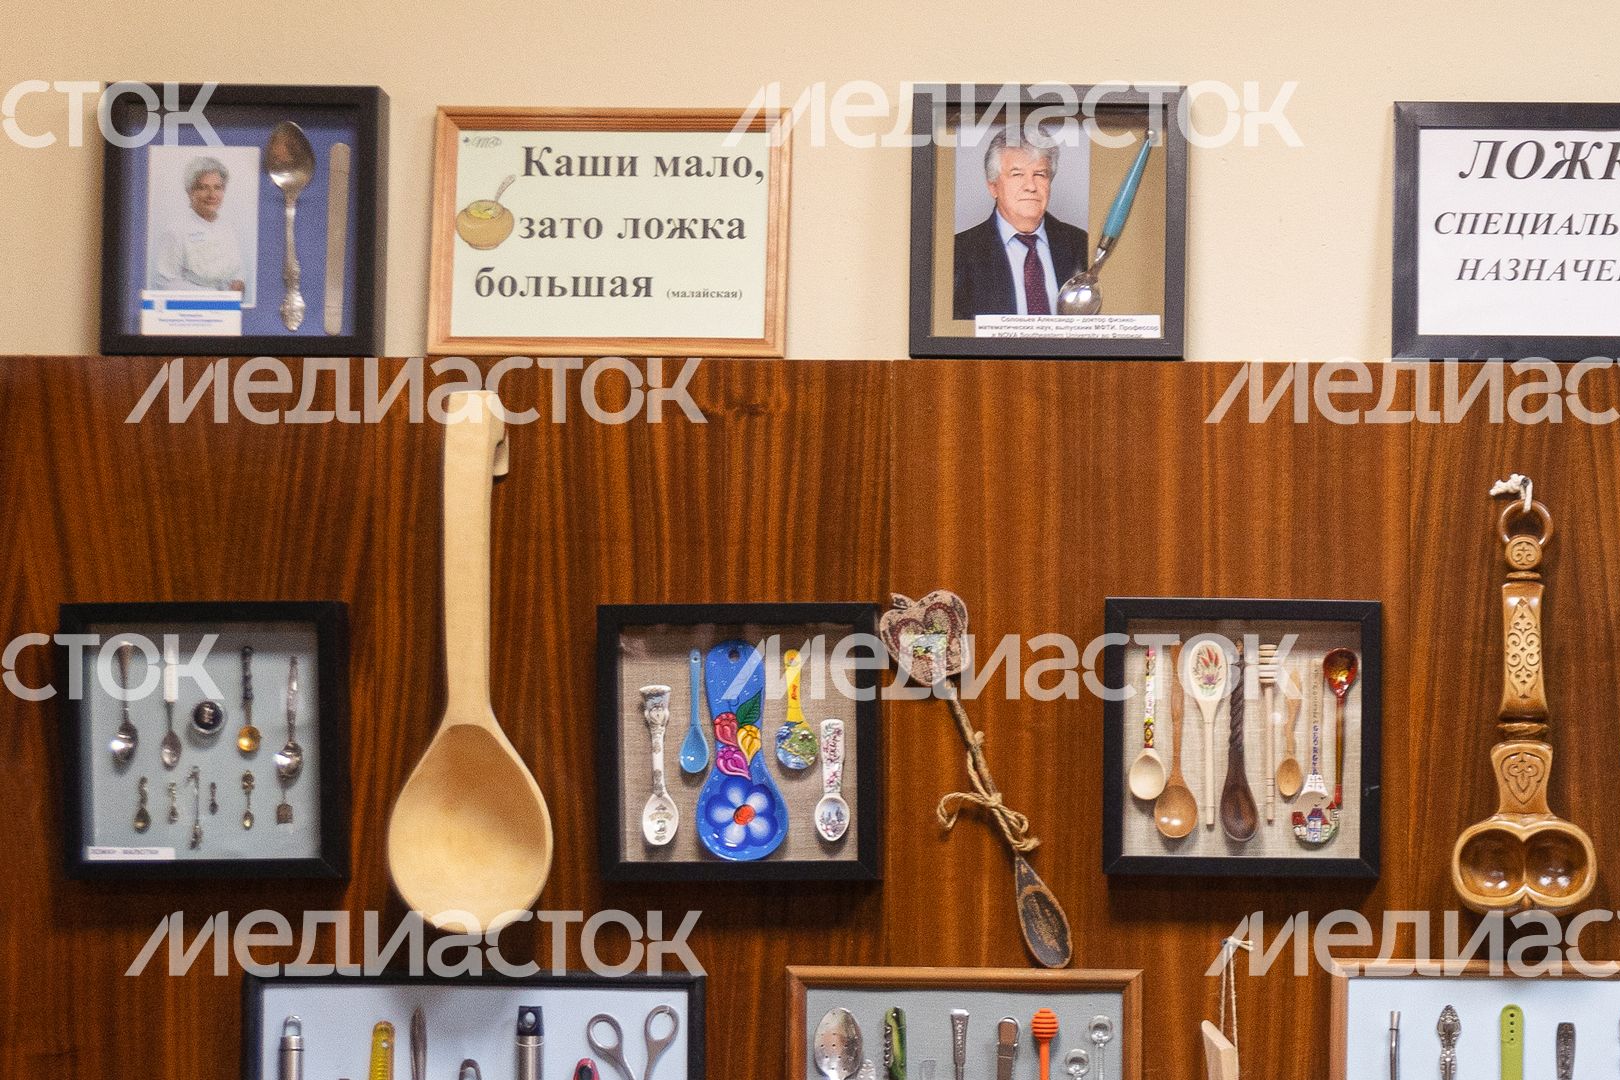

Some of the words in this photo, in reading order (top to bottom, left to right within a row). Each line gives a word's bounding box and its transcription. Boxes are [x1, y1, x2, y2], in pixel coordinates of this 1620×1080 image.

[523, 147, 637, 176] Каши
[655, 156, 765, 184] мало,
[520, 217, 603, 239] зато
[617, 218, 745, 239] ложка
[475, 267, 652, 297] большая
[667, 289, 742, 298] (малайская)
